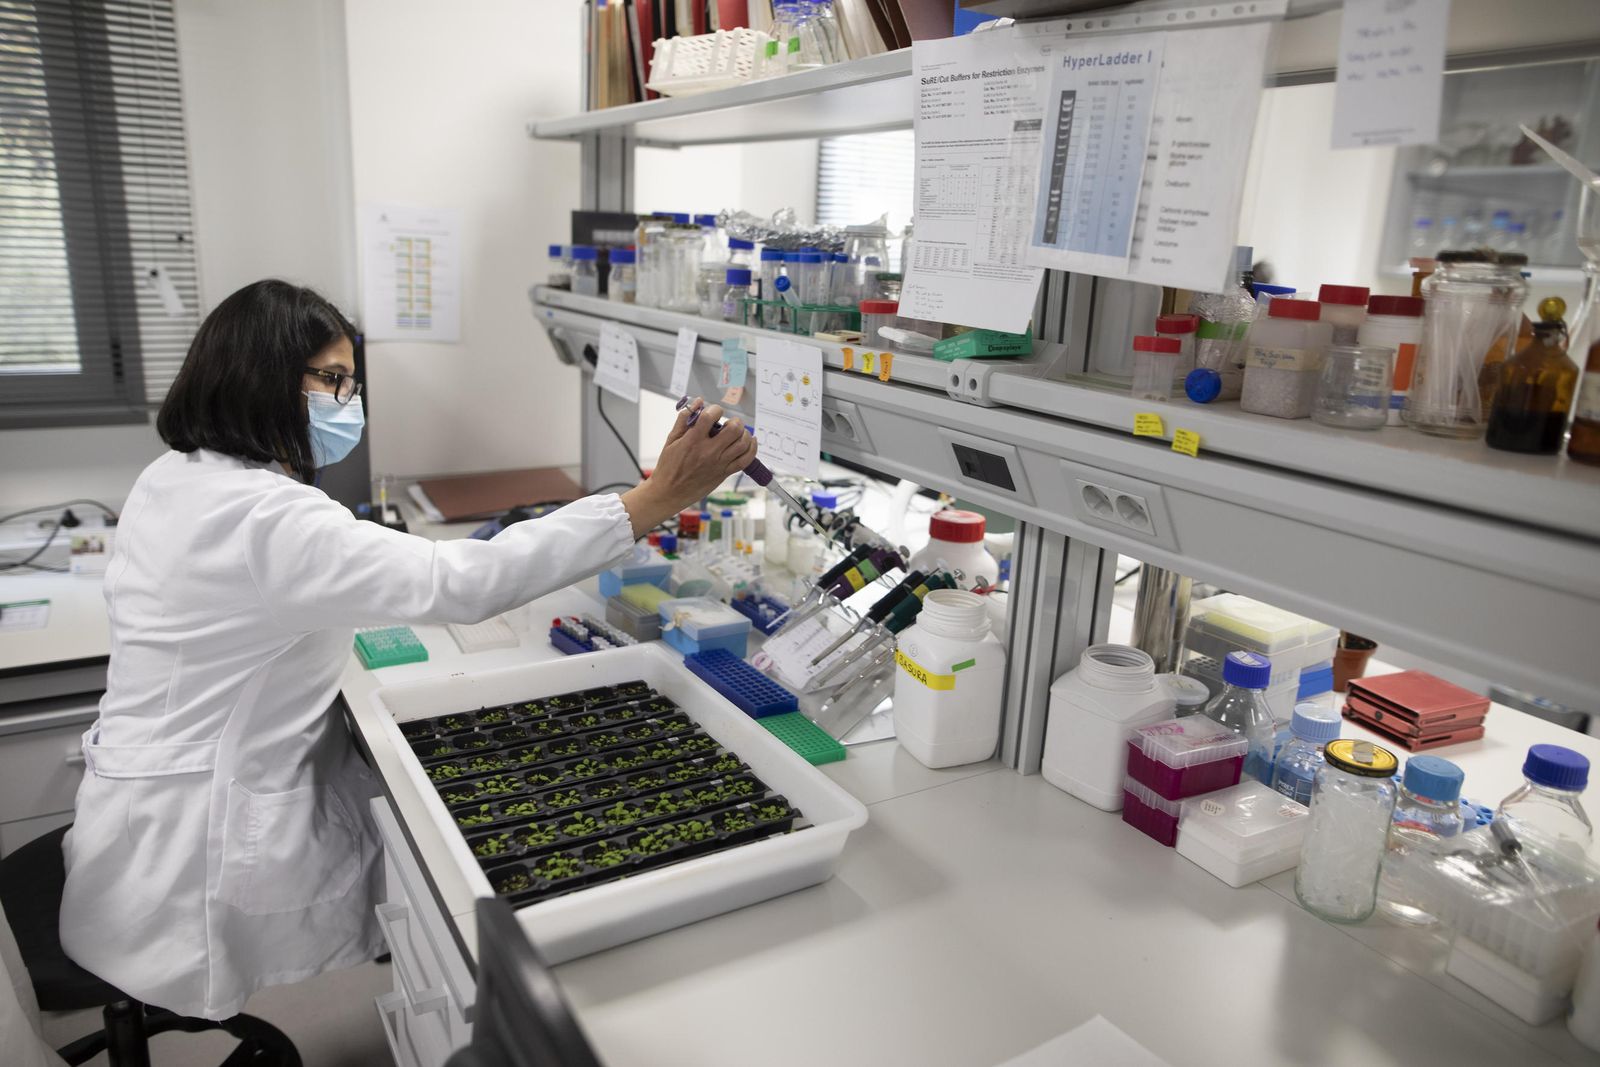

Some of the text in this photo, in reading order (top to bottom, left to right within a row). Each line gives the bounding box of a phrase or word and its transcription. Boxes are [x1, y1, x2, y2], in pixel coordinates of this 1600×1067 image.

[1063, 49, 1152, 71] HyperLadder I
[950, 72, 971, 83] Buffers
[971, 71, 981, 80] for
[981, 67, 1016, 78] Restriction
[1016, 65, 1045, 76] Enzymes
[898, 655, 928, 685] BASURA
